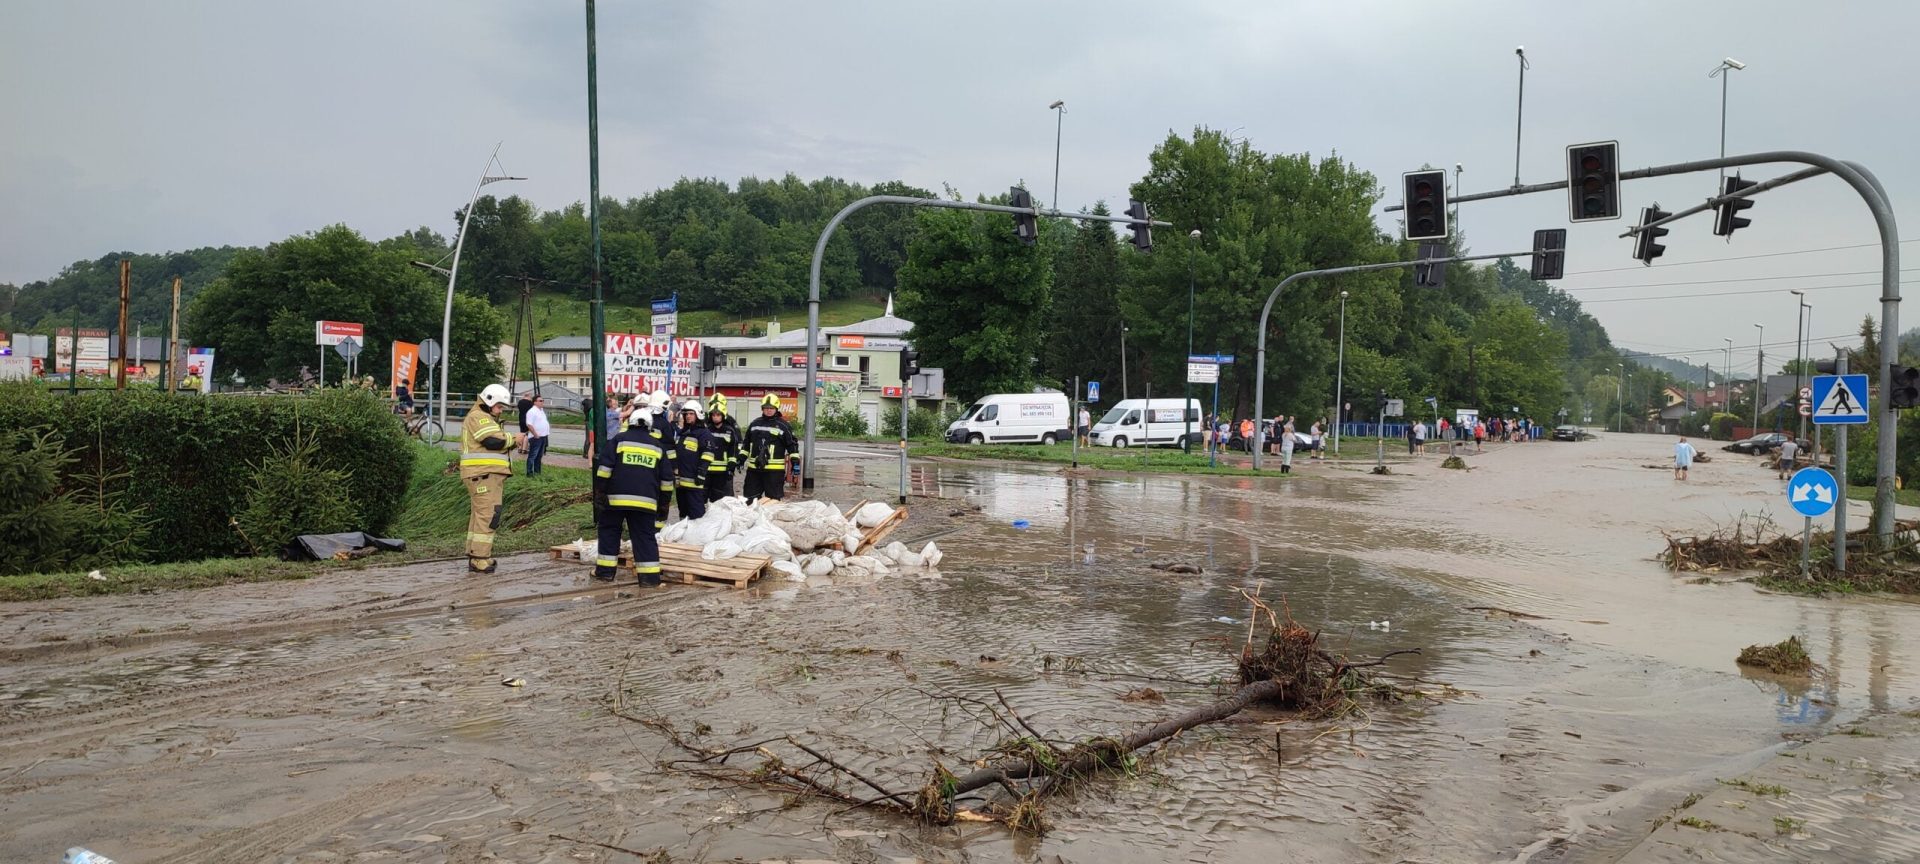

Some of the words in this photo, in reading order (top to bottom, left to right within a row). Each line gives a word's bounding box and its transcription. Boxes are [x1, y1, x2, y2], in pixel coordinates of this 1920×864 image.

[606, 335, 698, 359] KARTONY
[637, 367, 676, 375] Dunajcoa
[605, 374, 640, 394] FOLIE
[643, 376, 696, 396] STRETCH
